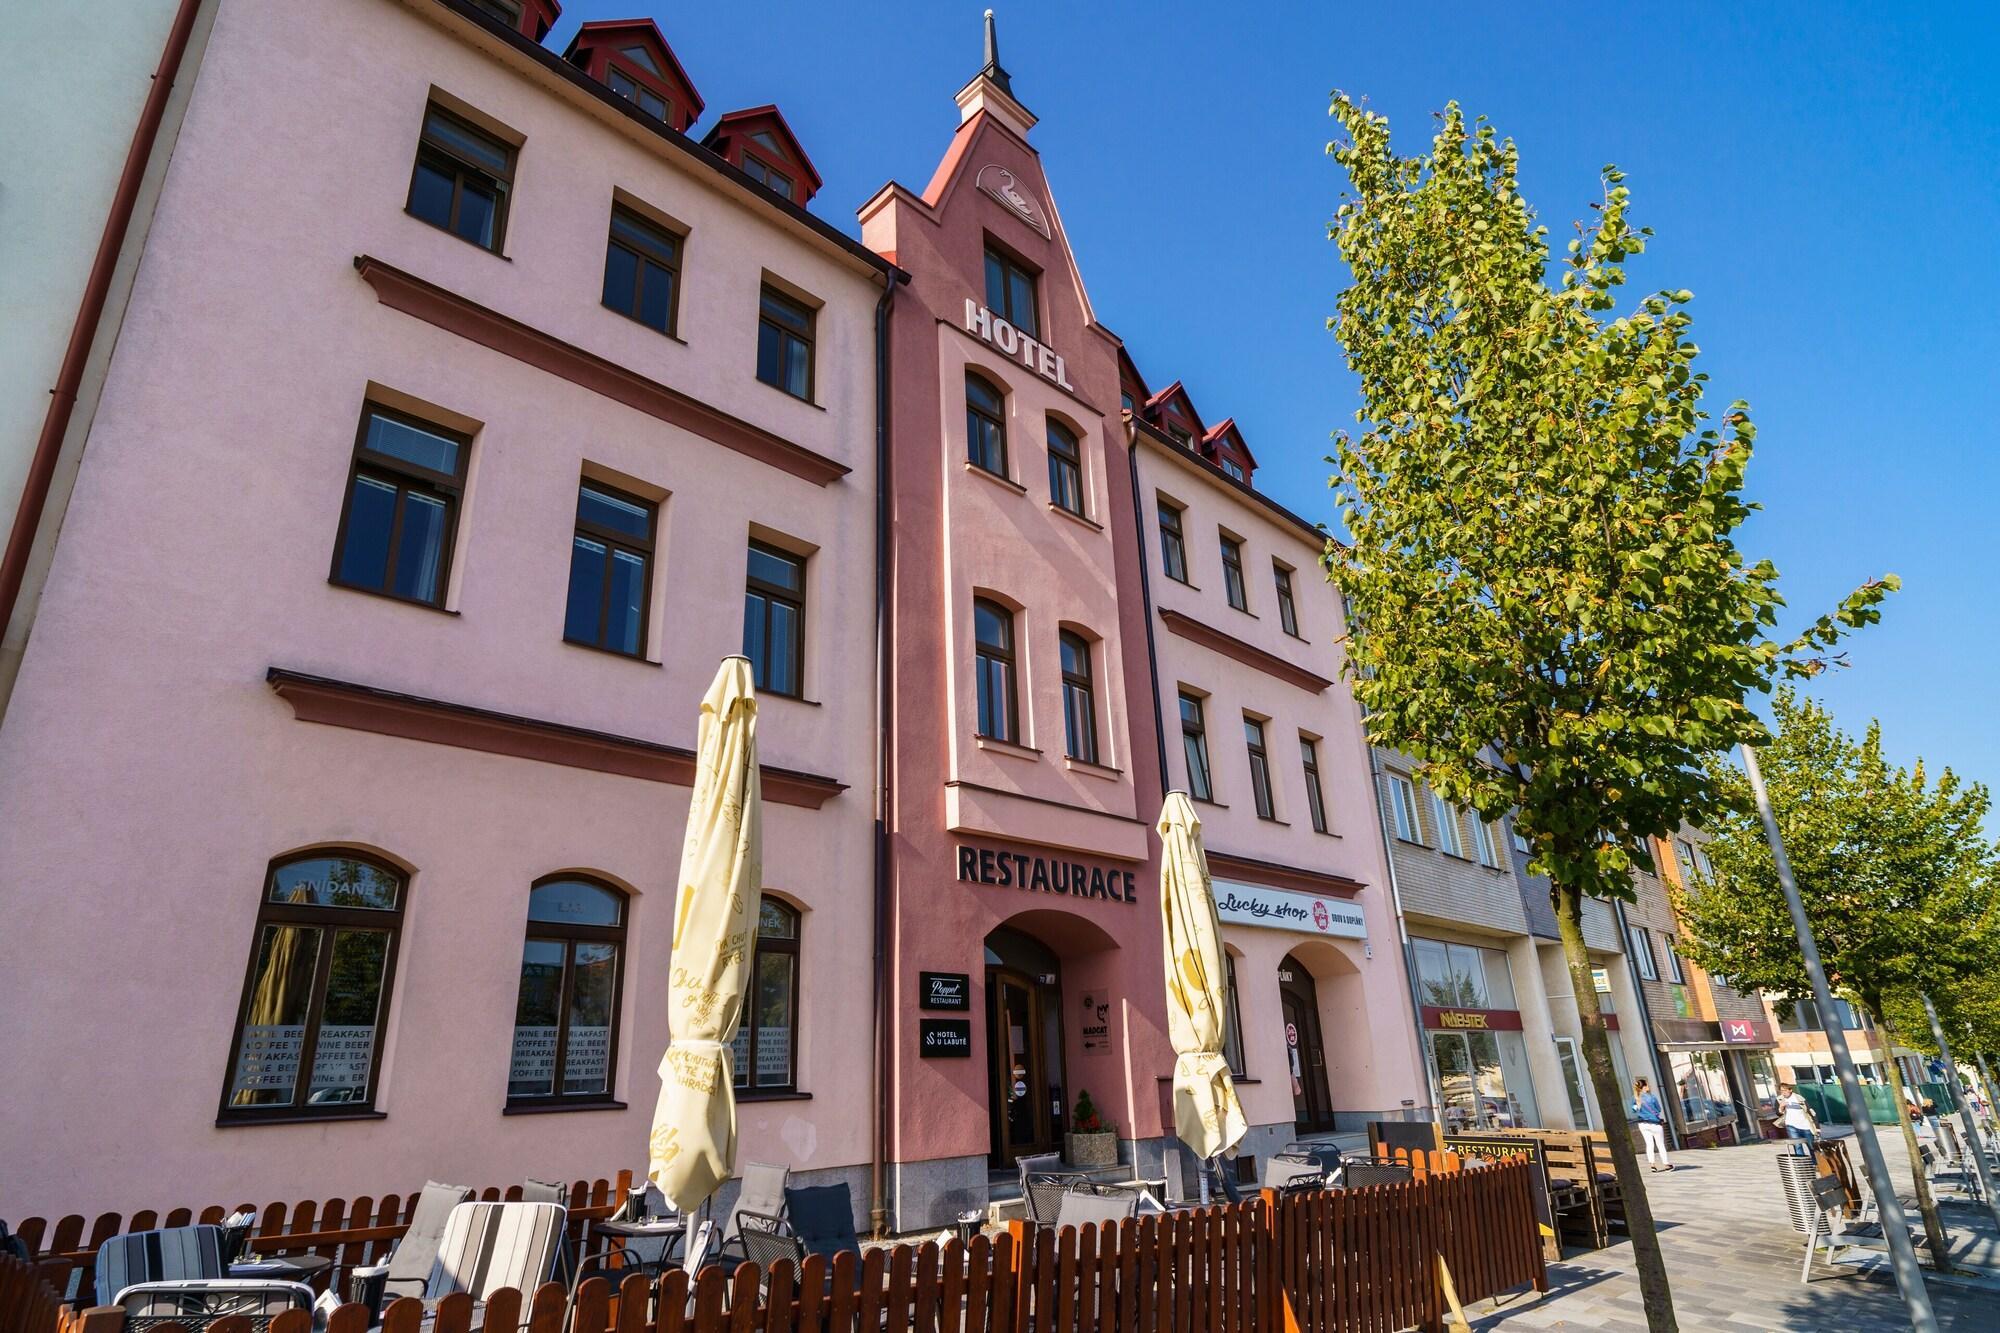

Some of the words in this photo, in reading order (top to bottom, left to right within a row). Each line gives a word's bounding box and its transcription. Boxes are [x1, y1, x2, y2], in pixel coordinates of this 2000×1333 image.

[965, 298, 1074, 393] HOTEL
[956, 844, 1137, 903] RESTAURACE
[1218, 893, 1276, 918] Lucky
[1275, 902, 1309, 921] shop
[930, 997, 962, 1005] RESTAURANT
[283, 1030, 304, 1038] BEE
[320, 1030, 372, 1038] REAKFAST
[517, 1030, 539, 1038] WINE
[543, 1030, 557, 1038] BEE
[568, 1030, 607, 1038] REAKFAST
[345, 1041, 370, 1049] BEER
[244, 1052, 300, 1061] BREAKFAS
[313, 1052, 346, 1060] OFFEE
[350, 1052, 368, 1060] TEA
[515, 1049, 555, 1057] BREAKFAS
[565, 1049, 590, 1057] OFFEE
[591, 1049, 605, 1057] TEA
[565, 1058, 604, 1066] REAKFAST
[278, 1063, 298, 1072] BEE
[512, 1069, 544, 1077] COFFEE
[1457, 1144, 1535, 1158] RESTAURANT
